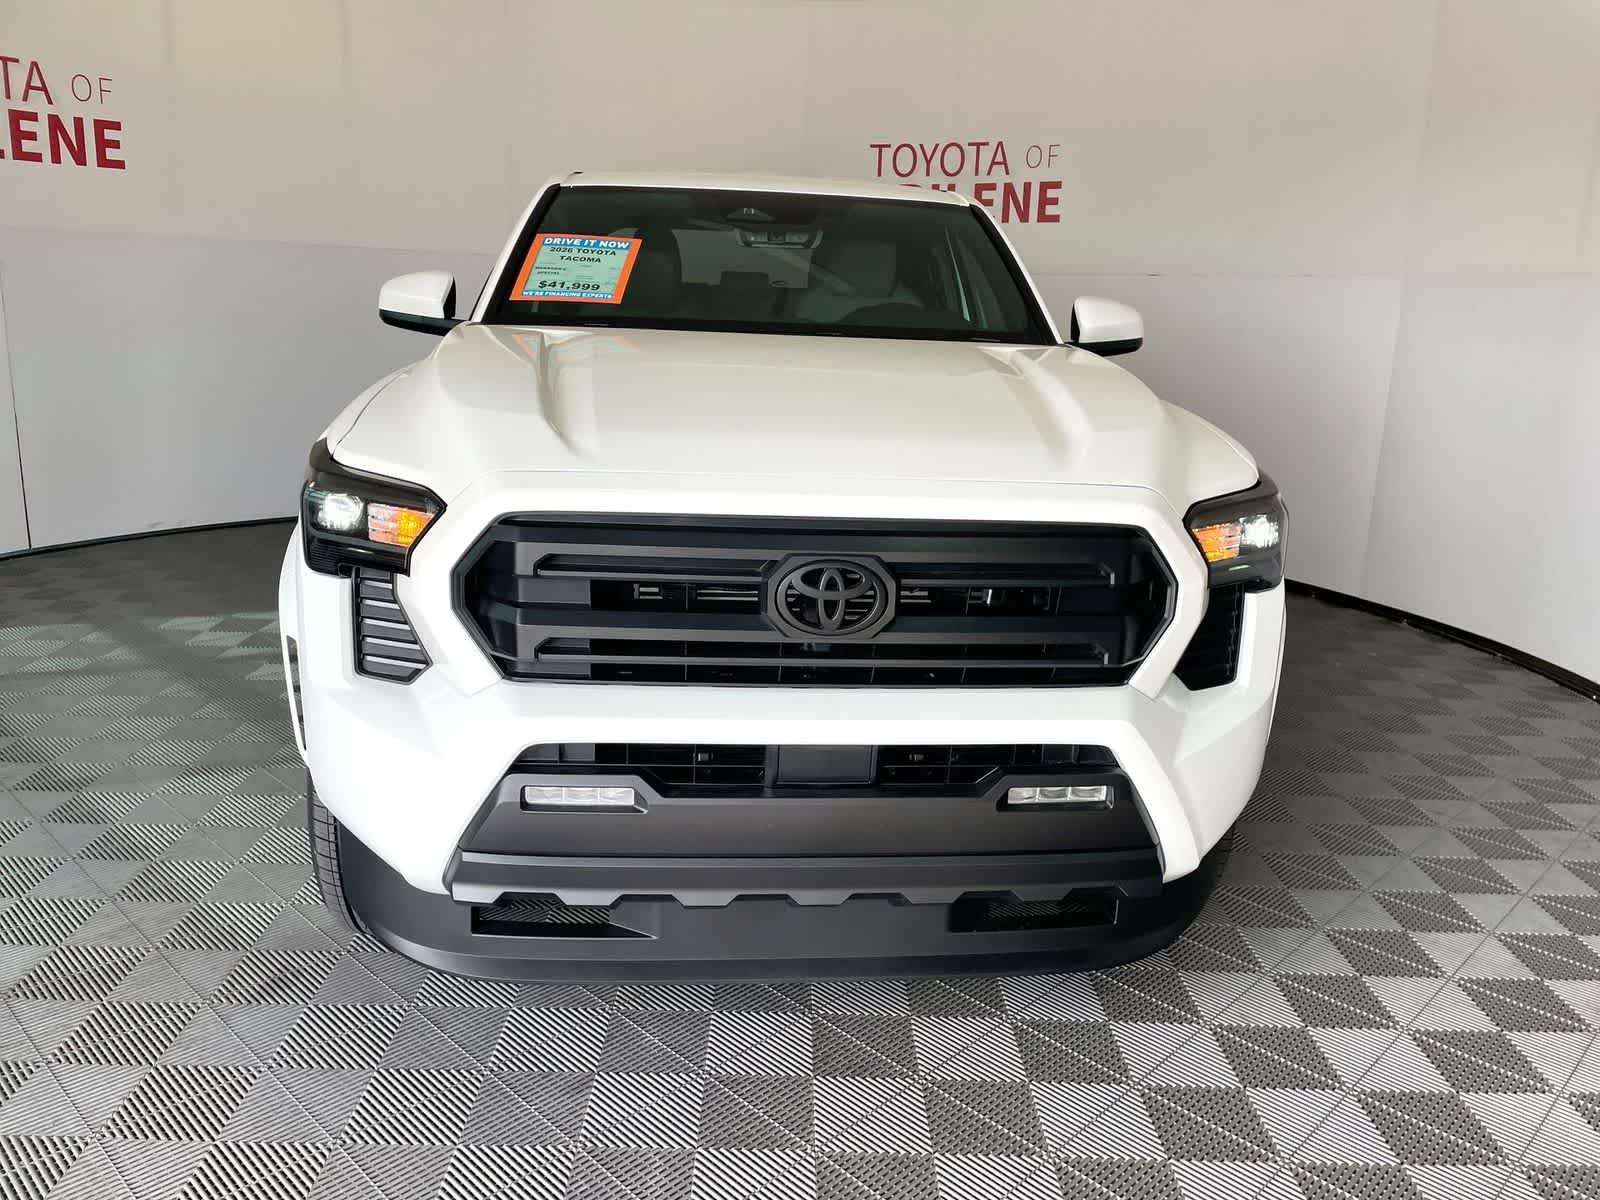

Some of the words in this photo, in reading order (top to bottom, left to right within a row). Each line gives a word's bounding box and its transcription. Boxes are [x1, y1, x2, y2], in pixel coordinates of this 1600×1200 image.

[71, 73, 113, 105] OF
[869, 140, 1010, 178] TOYOTA
[1025, 144, 1061, 169] OF
[543, 237, 581, 246] DRIVE
[583, 239, 596, 247] IT
[598, 240, 630, 249] NOW
[575, 248, 617, 256] TOYOTA
[559, 255, 602, 263] TACOMA
[538, 280, 601, 291] $41,999
